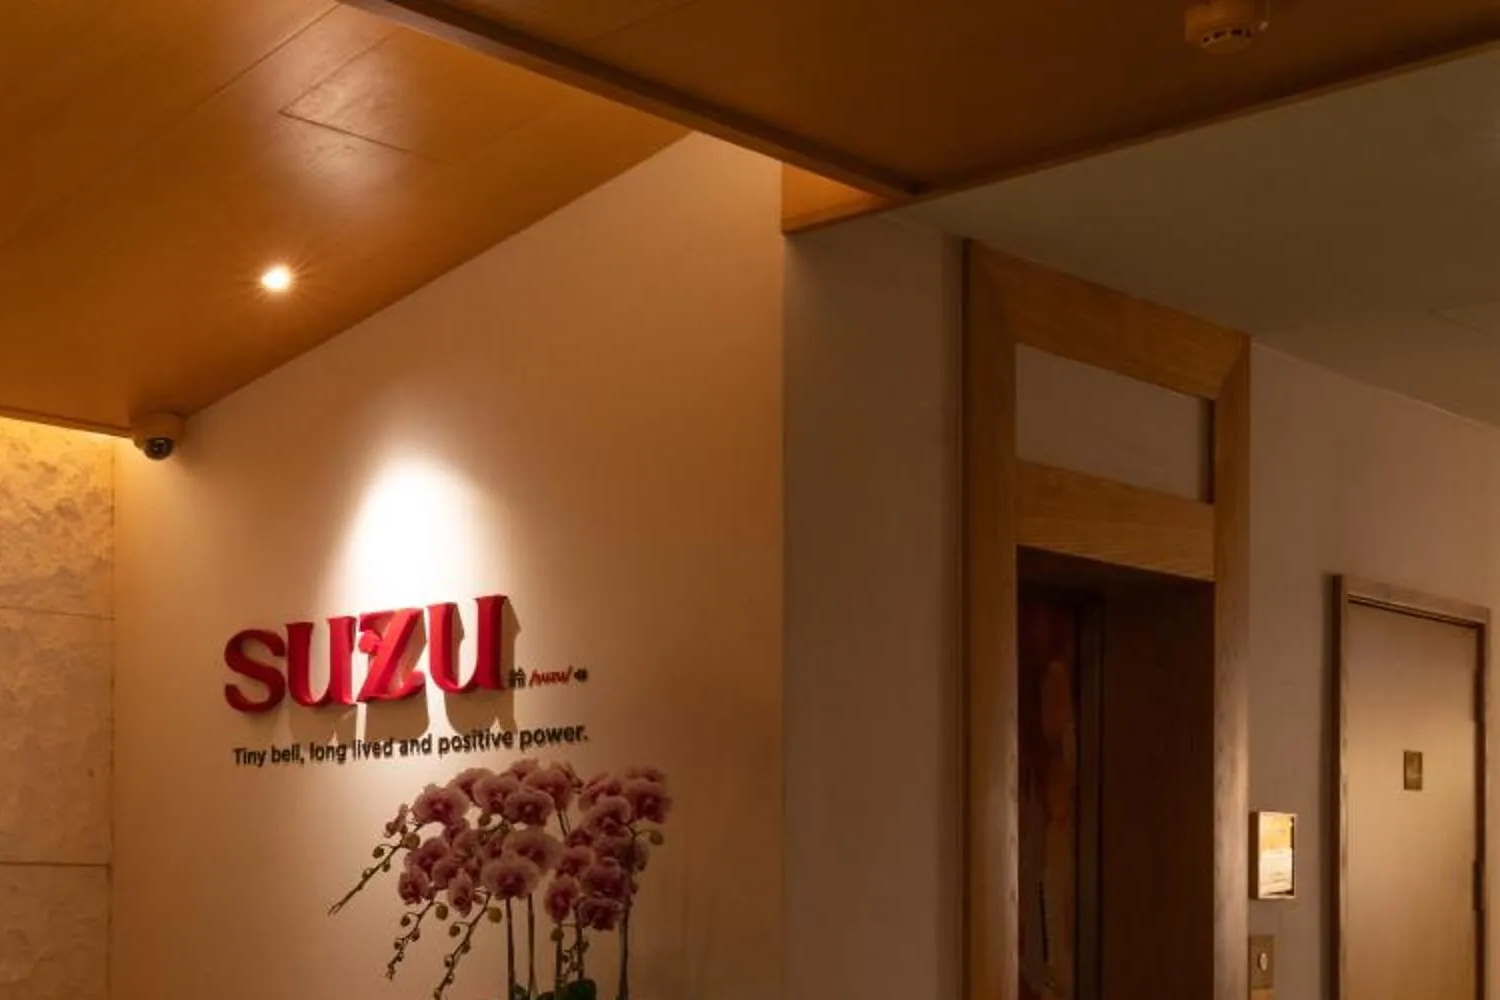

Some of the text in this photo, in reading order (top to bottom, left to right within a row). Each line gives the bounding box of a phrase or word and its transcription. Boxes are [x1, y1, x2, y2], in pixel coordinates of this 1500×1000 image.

[234, 725, 588, 767] Tiny bell, long lived and positive power.
